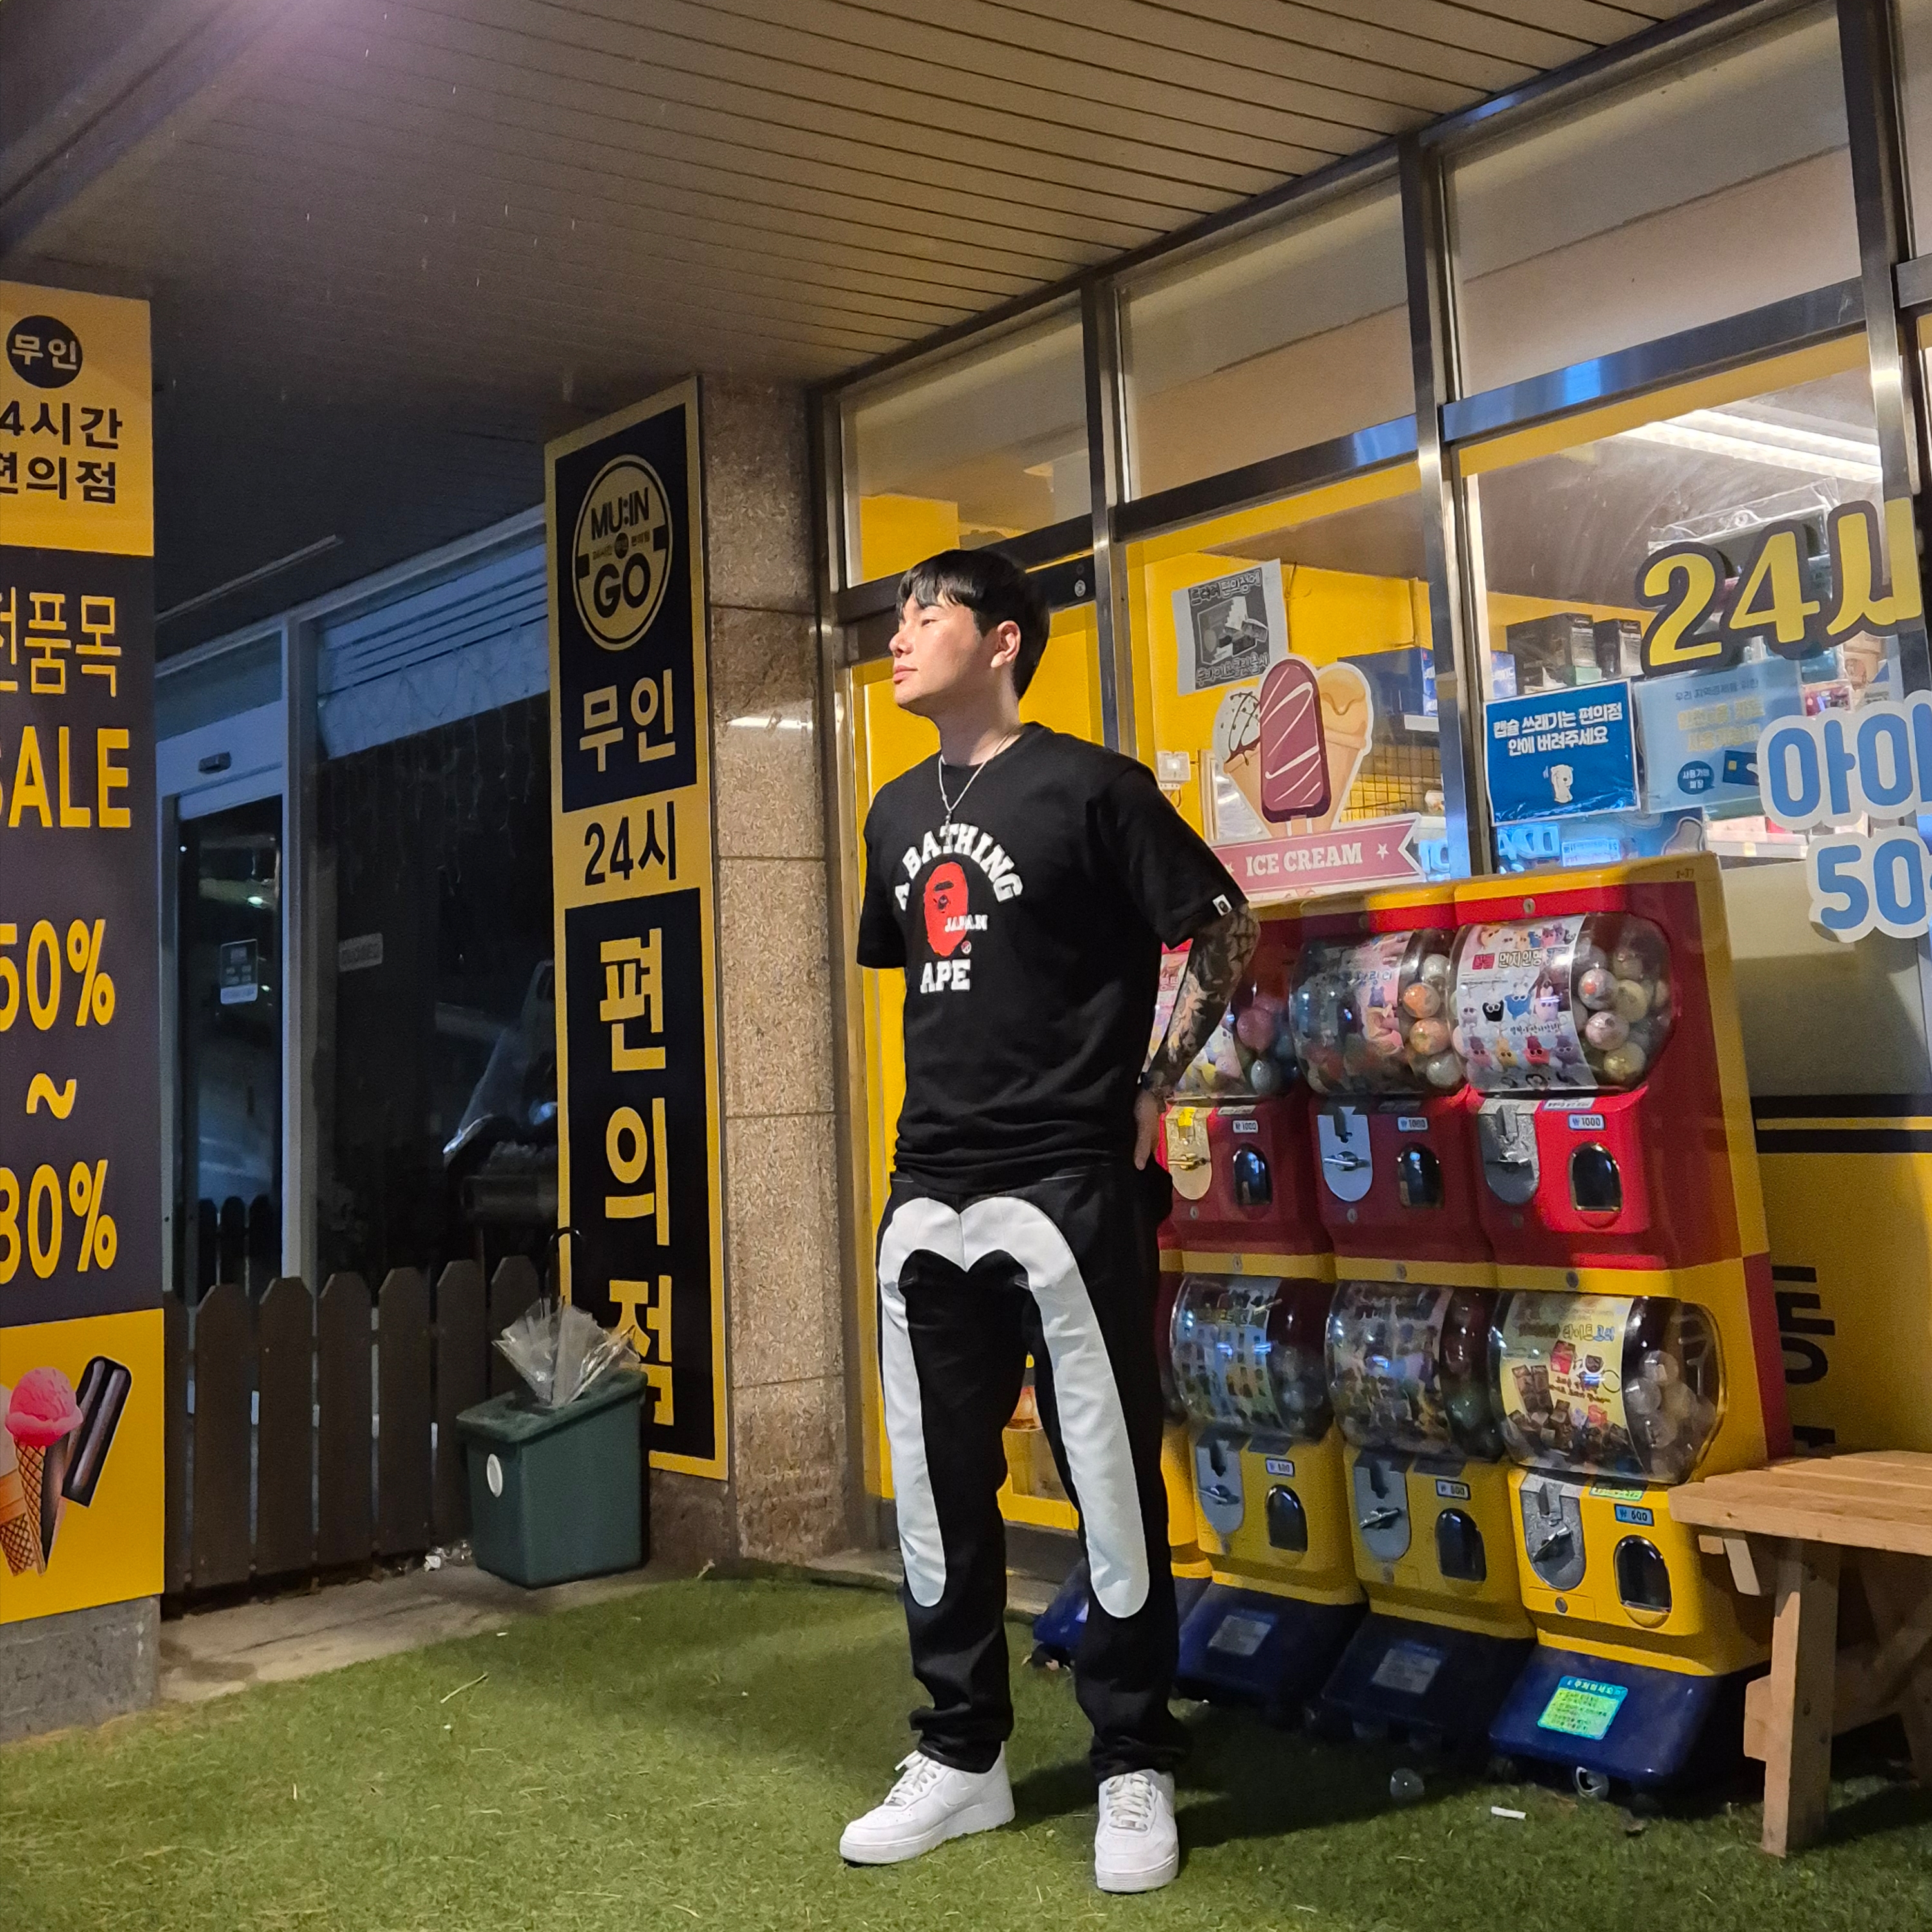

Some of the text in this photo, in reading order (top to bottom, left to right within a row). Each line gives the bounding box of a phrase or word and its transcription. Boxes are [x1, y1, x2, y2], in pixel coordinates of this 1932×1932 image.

[12, 334, 77, 370] 무인
[0, 401, 123, 450] 4시간
[593, 552, 652, 619] GO
[1641, 496, 1922, 667] 24시
[580, 668, 676, 772] 무인
[1493, 702, 1623, 739] 캡슐 쓰레기는 편의점
[1508, 726, 1609, 757] 안에 버려주세요
[0, 725, 131, 828] ALE
[1768, 703, 1932, 817] 아이
[584, 800, 676, 886] 24시
[895, 823, 1024, 912] A BATHING
[1245, 842, 1363, 877] ICE CREAM
[1817, 838, 1932, 929] 50
[944, 914, 988, 933] JAPAN
[0, 918, 115, 1030] 50%
[920, 959, 971, 994] APE
[1498, 949, 1543, 969] 먼지인형
[1581, 1117, 1601, 1126] 1000
[1631, 1510, 1648, 1522] 600
